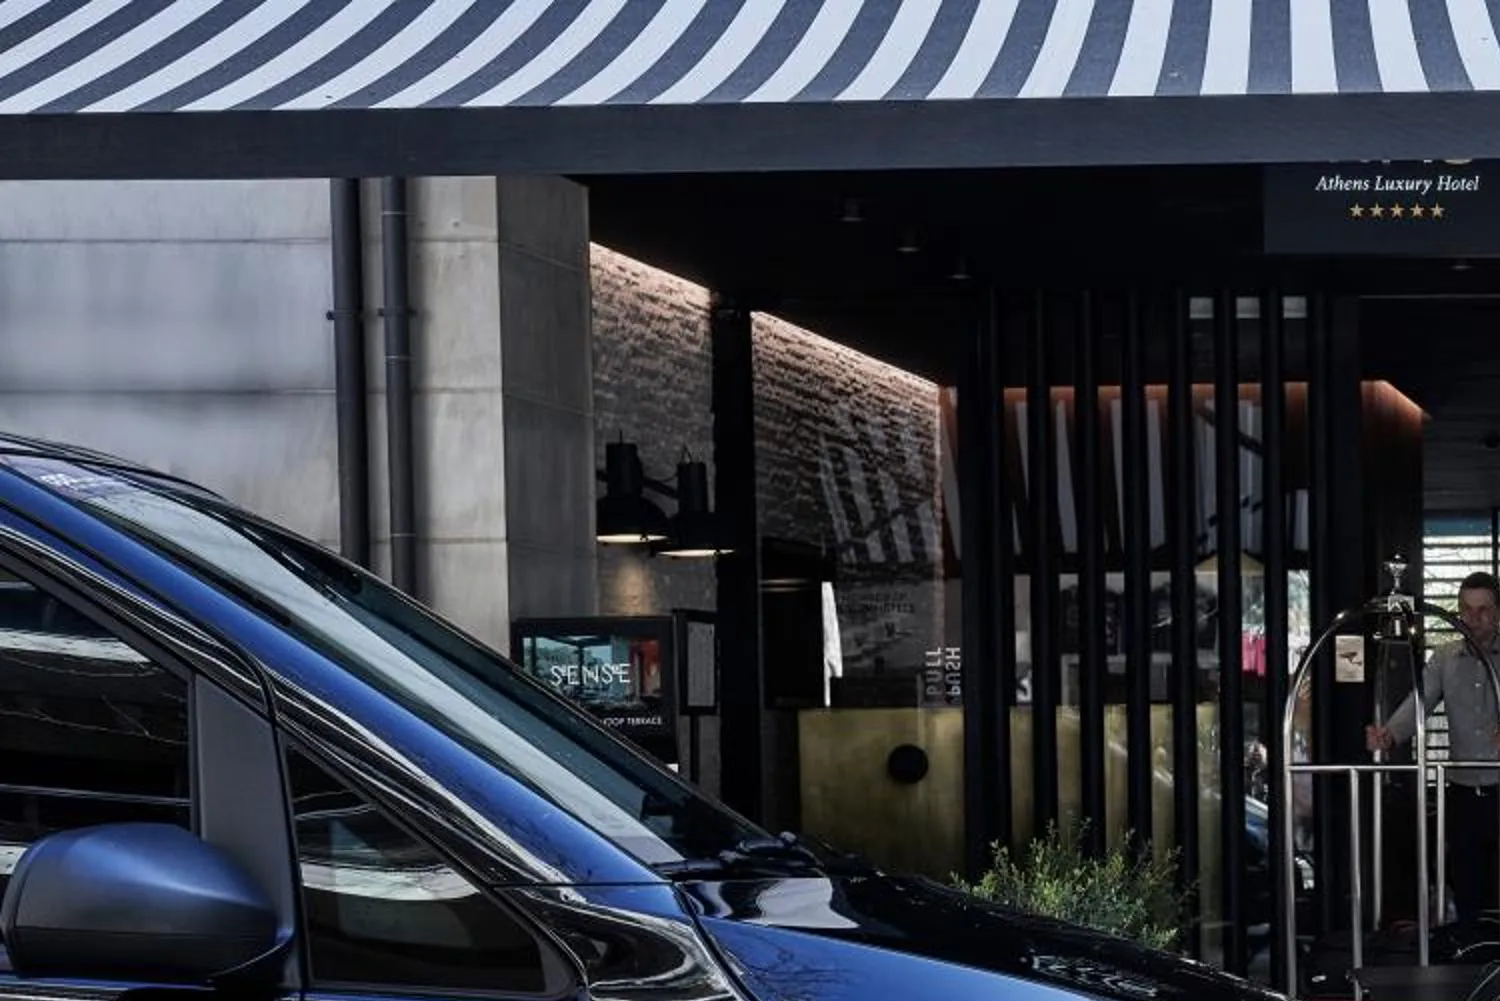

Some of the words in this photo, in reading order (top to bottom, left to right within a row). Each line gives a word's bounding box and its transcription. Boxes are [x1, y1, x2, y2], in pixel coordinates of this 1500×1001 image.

[1315, 174, 1370, 192] Athens
[1374, 175, 1433, 195] Luxury
[1437, 174, 1480, 191] Hotel
